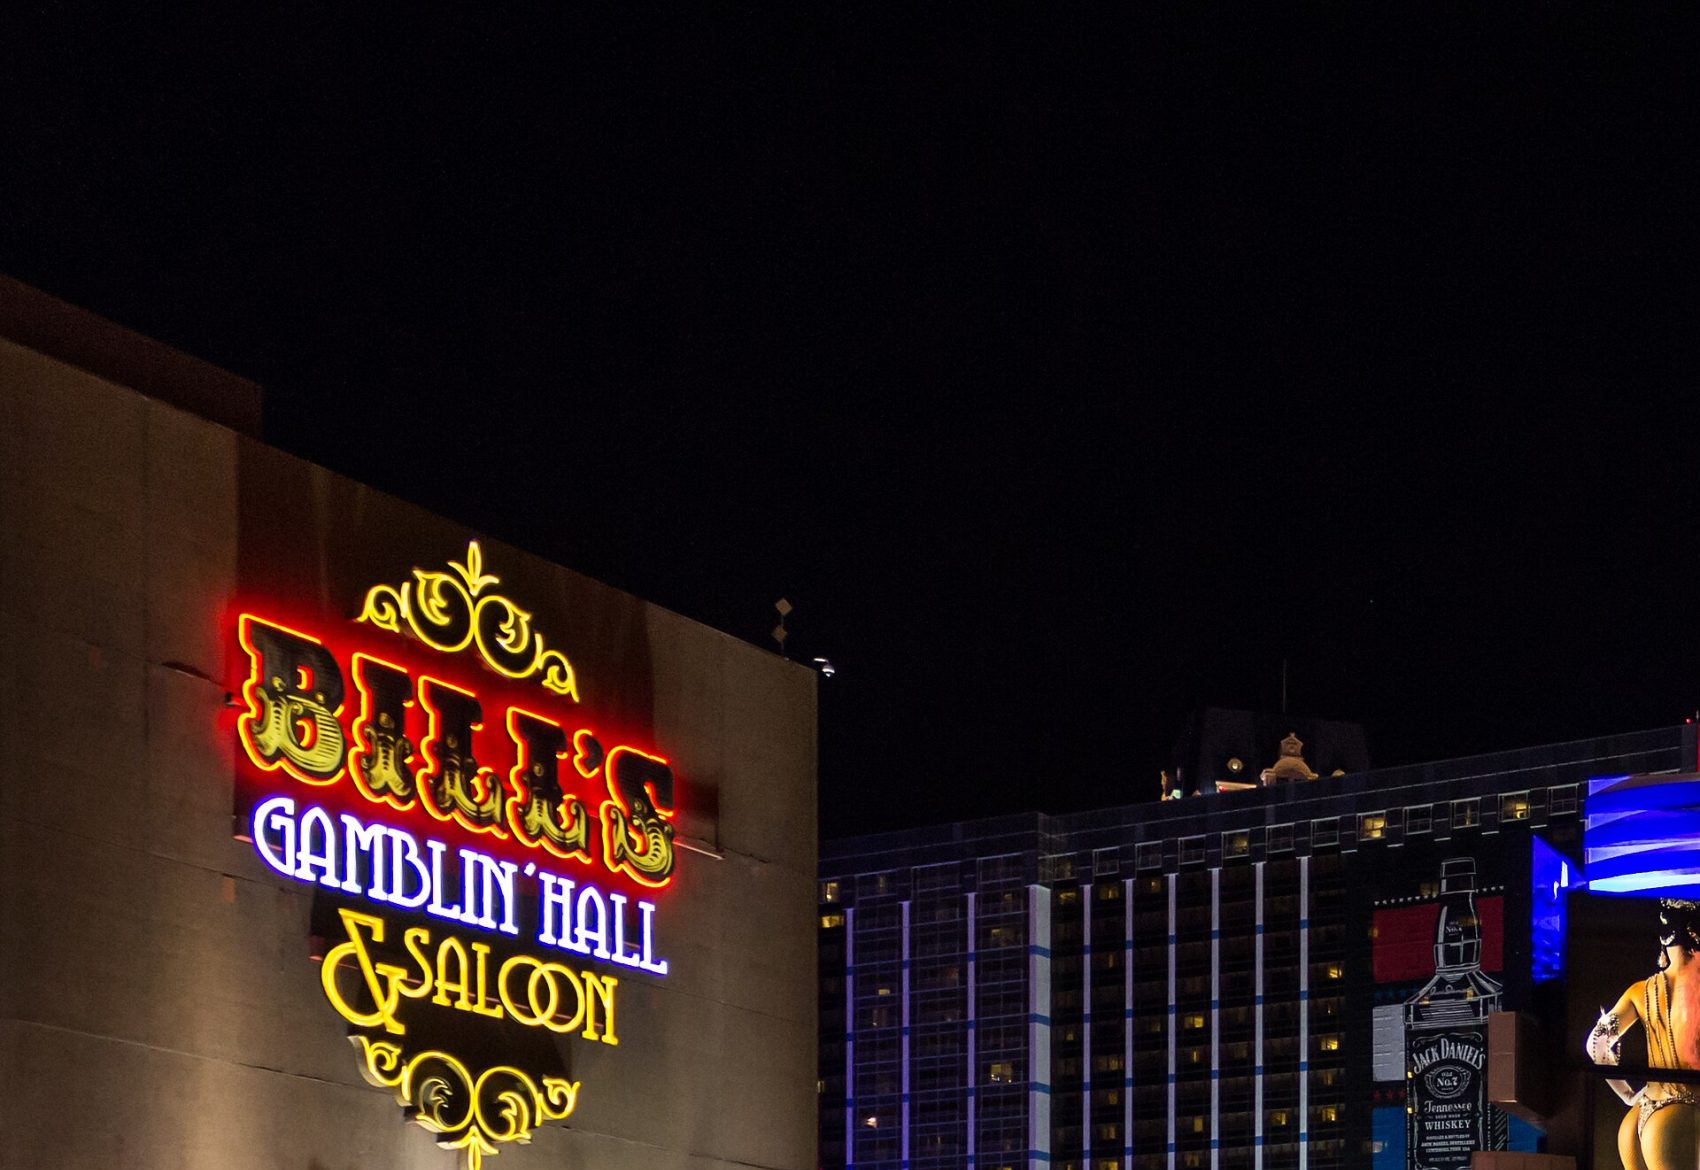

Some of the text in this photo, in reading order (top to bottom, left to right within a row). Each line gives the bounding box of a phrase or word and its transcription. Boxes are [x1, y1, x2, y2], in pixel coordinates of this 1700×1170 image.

[239, 613, 676, 887] BILL'S
[538, 871, 668, 976] HALL
[398, 926, 619, 1046] SALOON
[1412, 1037, 1486, 1074] JACK DANIEL'S
[1425, 1120, 1471, 1131] WHISKEY
